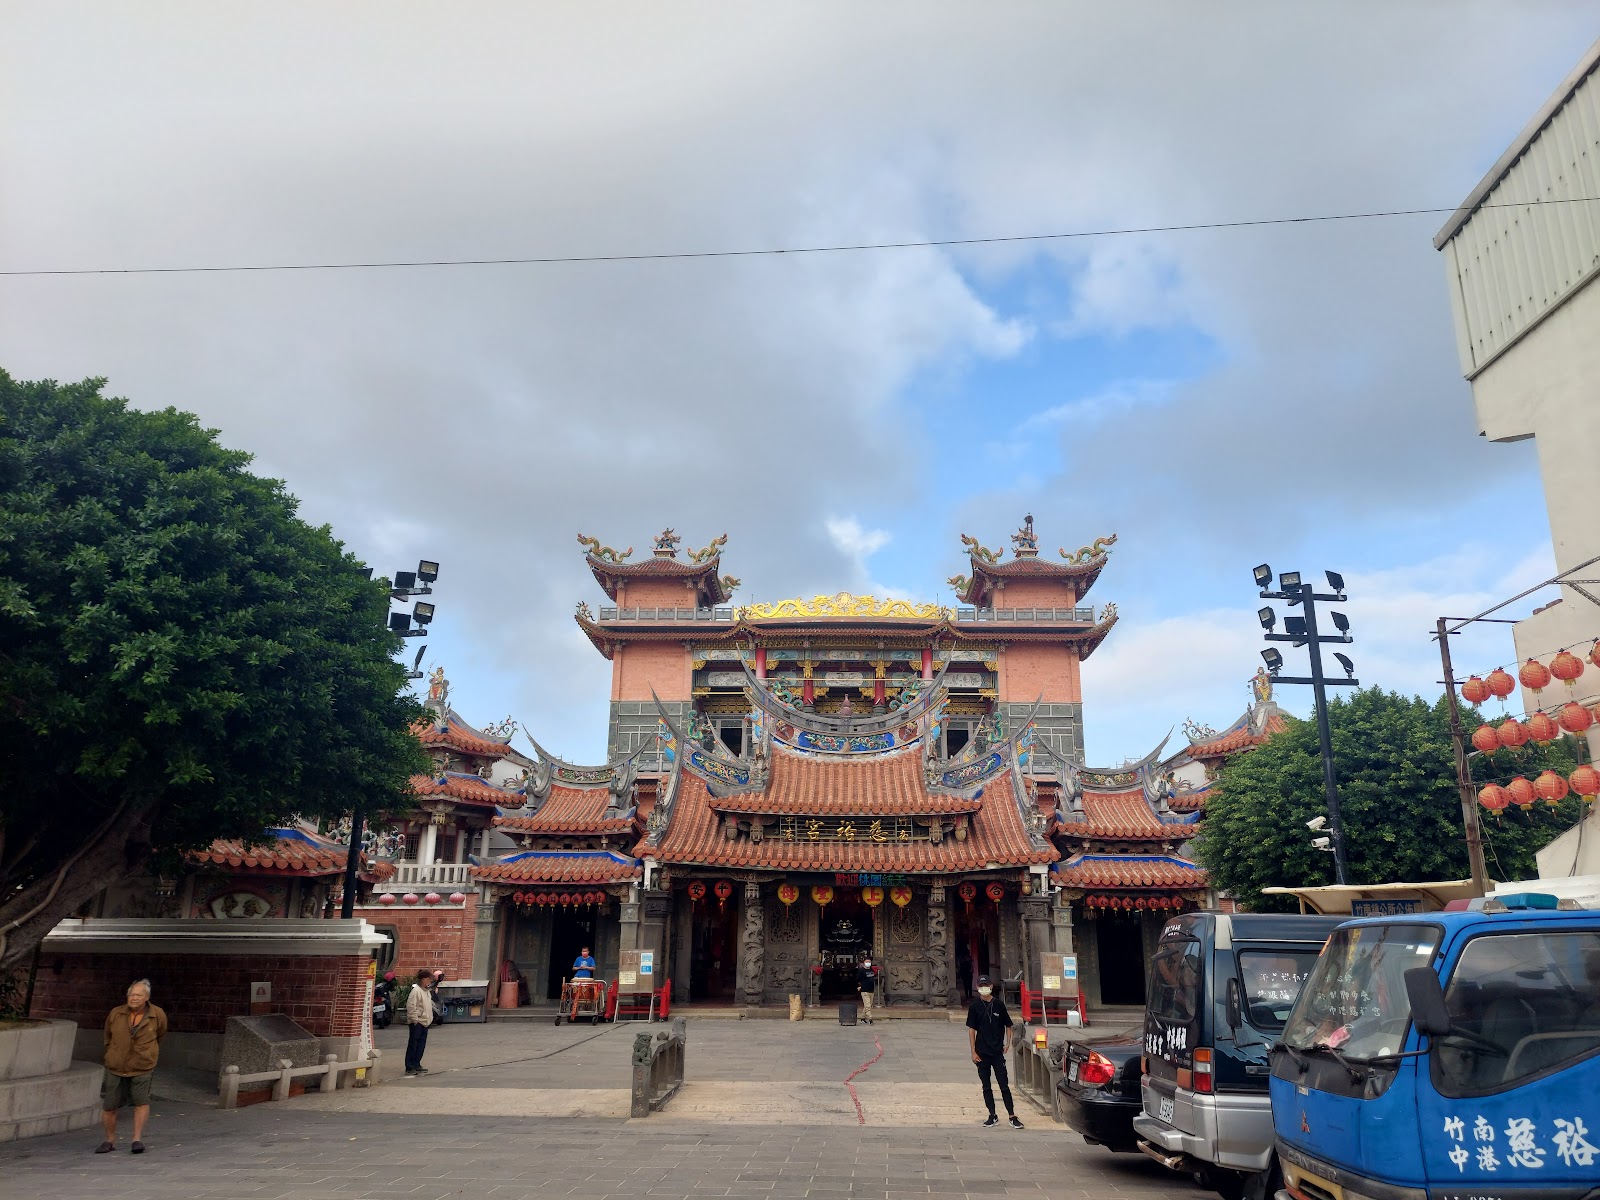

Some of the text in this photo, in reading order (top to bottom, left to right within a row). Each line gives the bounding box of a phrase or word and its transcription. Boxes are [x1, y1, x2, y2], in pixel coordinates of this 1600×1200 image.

[804, 818, 889, 842] 慈裕宮
[1443, 1114, 1495, 1142] 竹南
[1503, 1116, 1600, 1168] 慈裕
[1447, 1144, 1501, 1174] 中港
